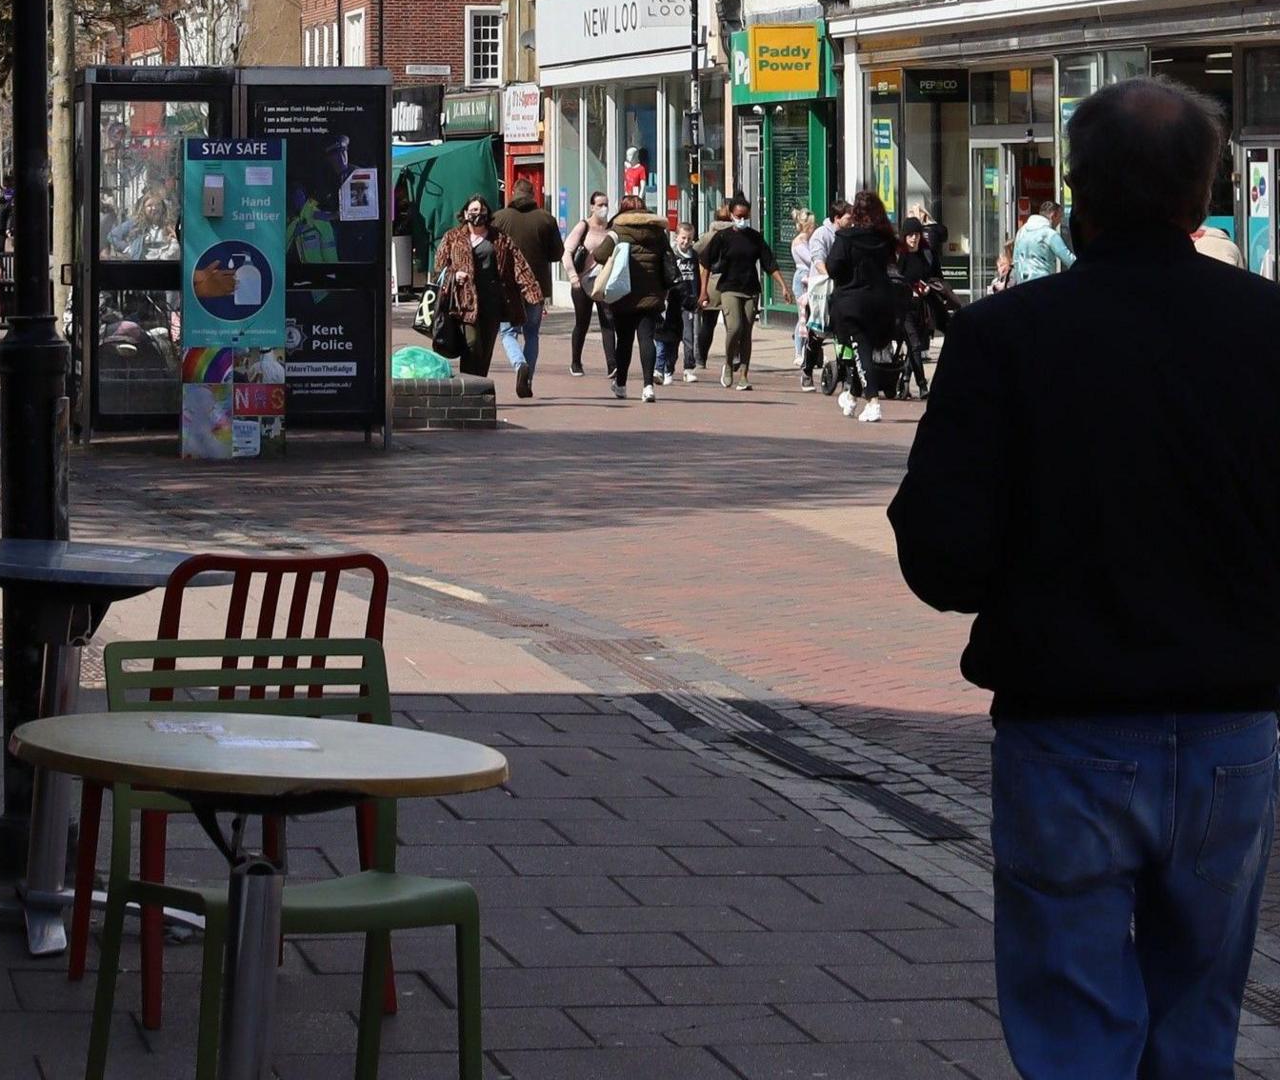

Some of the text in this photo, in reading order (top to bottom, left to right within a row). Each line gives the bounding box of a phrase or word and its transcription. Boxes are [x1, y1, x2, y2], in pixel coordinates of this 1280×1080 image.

[648, 5, 693, 17] LOO
[584, 1, 638, 37] NEW LOO
[759, 46, 810, 59] Paddy
[759, 60, 811, 71] Power
[202, 143, 267, 155] STAY SAFE
[241, 196, 271, 207] Hand
[232, 210, 280, 221] Sanitiser
[312, 325, 344, 335] Kent
[312, 340, 353, 350] Police
